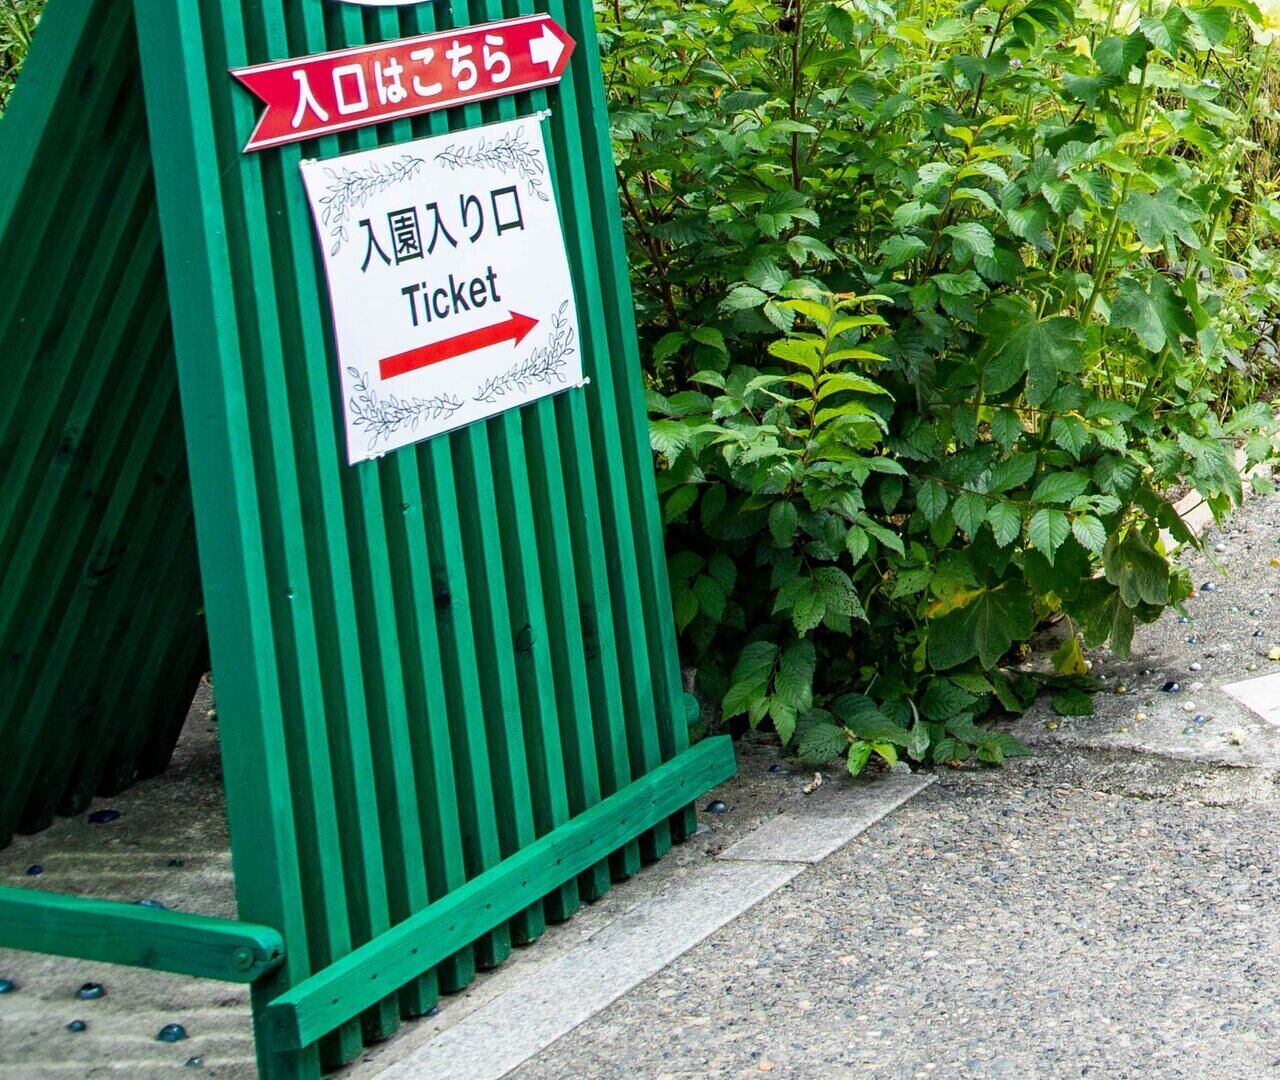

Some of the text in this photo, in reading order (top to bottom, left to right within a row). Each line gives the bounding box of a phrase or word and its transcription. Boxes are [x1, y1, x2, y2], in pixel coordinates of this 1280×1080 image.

[292, 34, 511, 128] 入口はこちら
[358, 184, 525, 273] 入園入り口
[401, 266, 501, 326] Ticket
